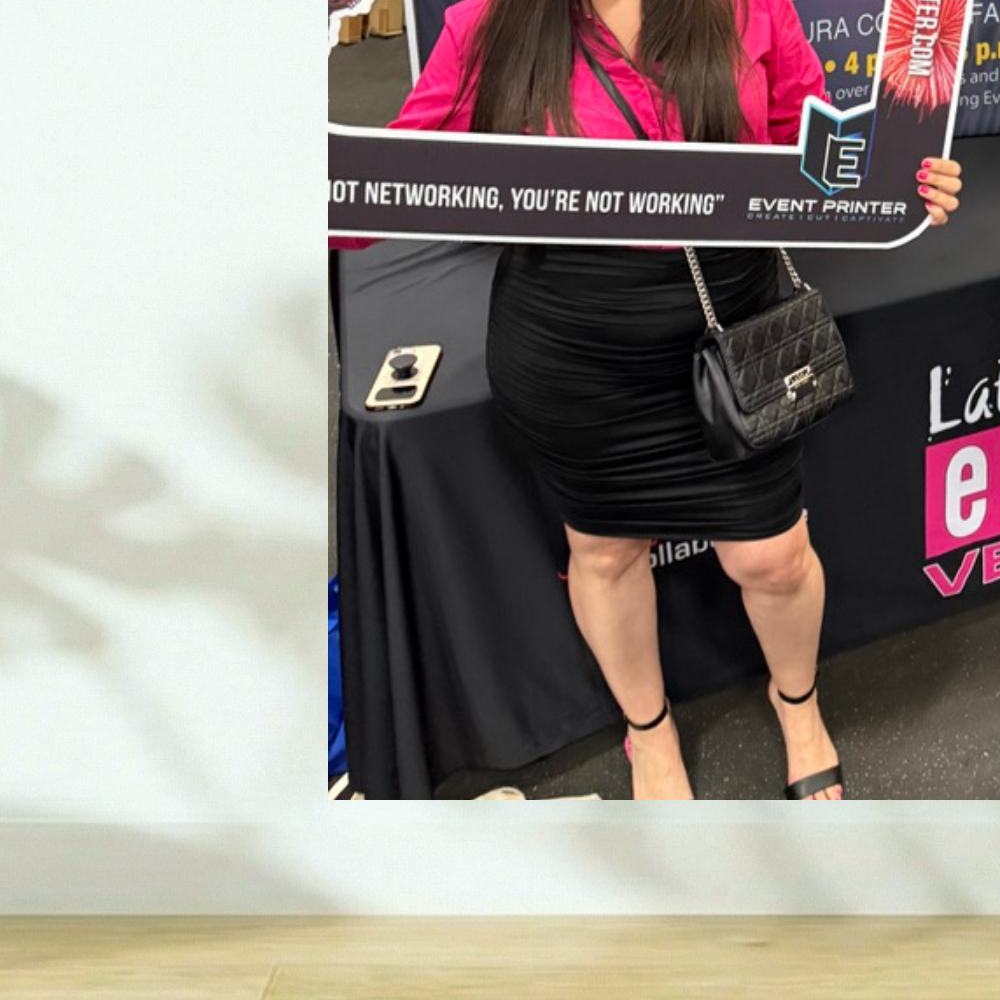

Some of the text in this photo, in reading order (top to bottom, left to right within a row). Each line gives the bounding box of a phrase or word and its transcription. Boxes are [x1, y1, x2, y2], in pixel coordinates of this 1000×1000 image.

[835, 84, 870, 100] over
[969, 67, 999, 84] and
[364, 181, 504, 212] NETWORKING,
[511, 187, 581, 212] YOU'RE
[585, 190, 624, 214] NOT
[628, 192, 725, 215] WORKING”
[748, 198, 908, 216] EVENT PRINTER
